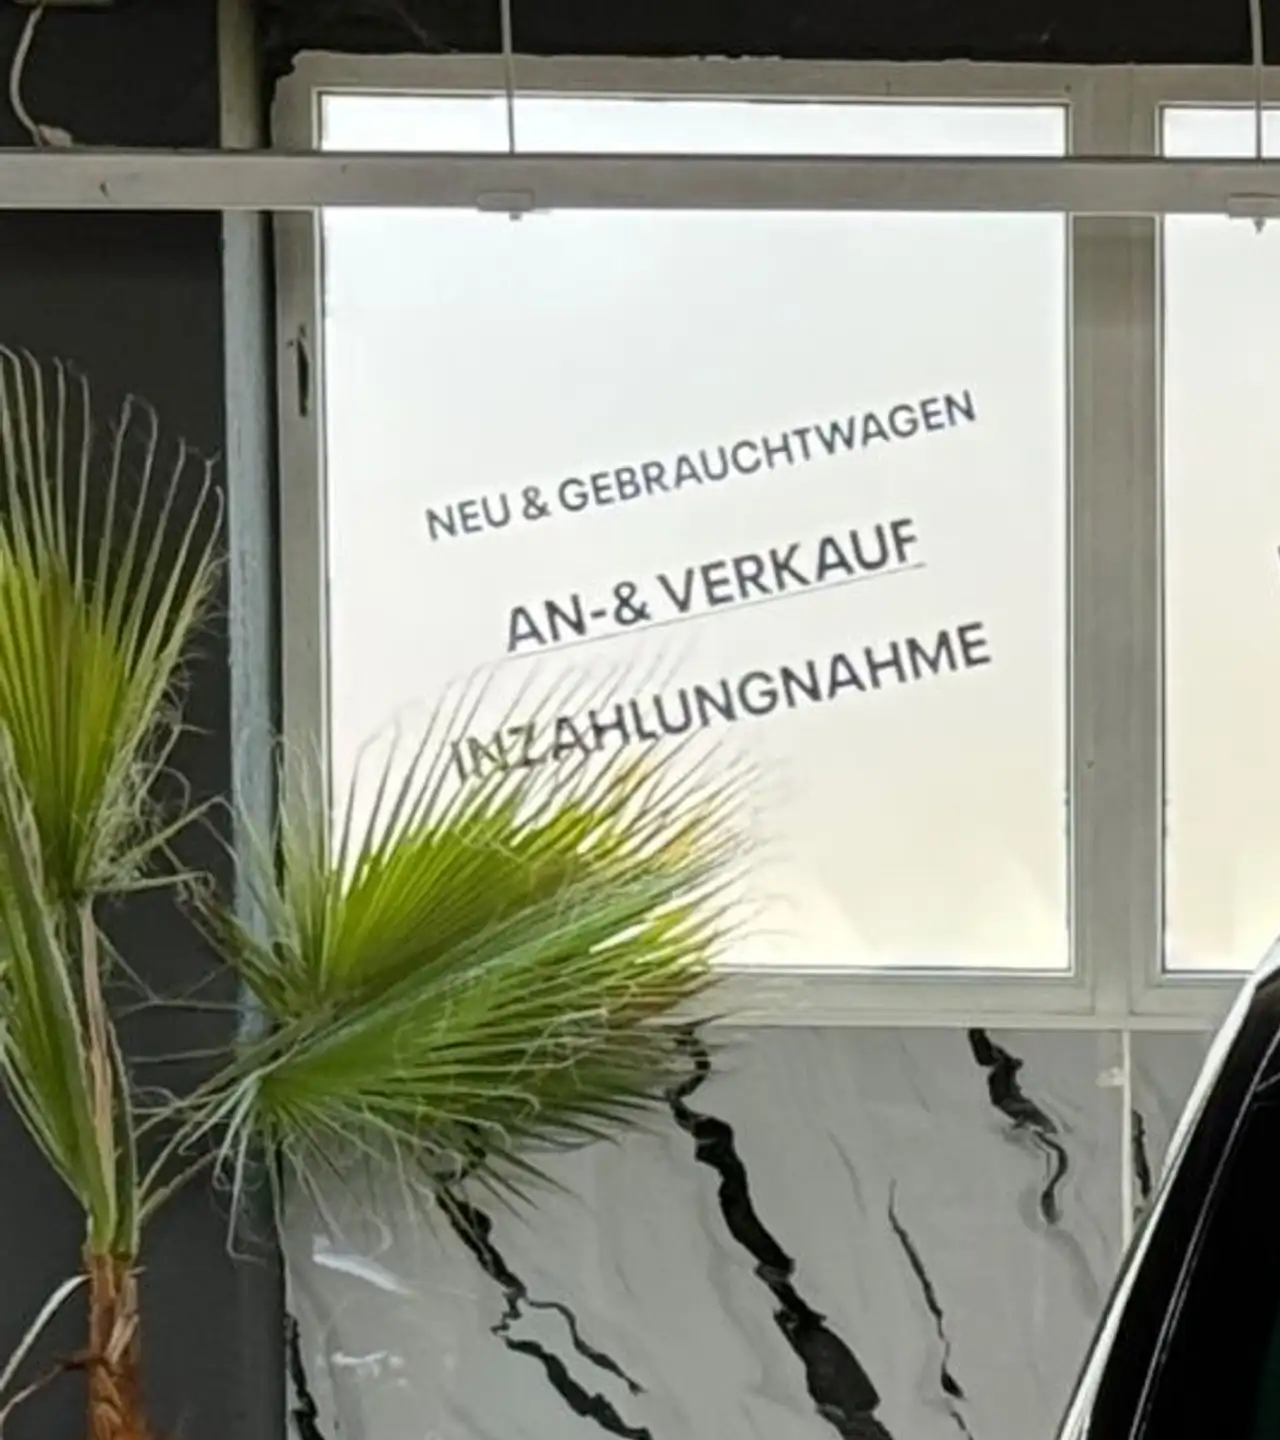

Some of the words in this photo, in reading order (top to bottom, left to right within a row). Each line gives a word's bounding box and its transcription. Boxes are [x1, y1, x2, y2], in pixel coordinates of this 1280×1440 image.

[425, 493, 511, 541] NEU
[521, 486, 551, 520] &
[557, 390, 976, 514] GEBRAUCHTWAGEN
[657, 517, 919, 613] VERKAUF
[451, 621, 992, 784] INZAHLUNGNAHME
